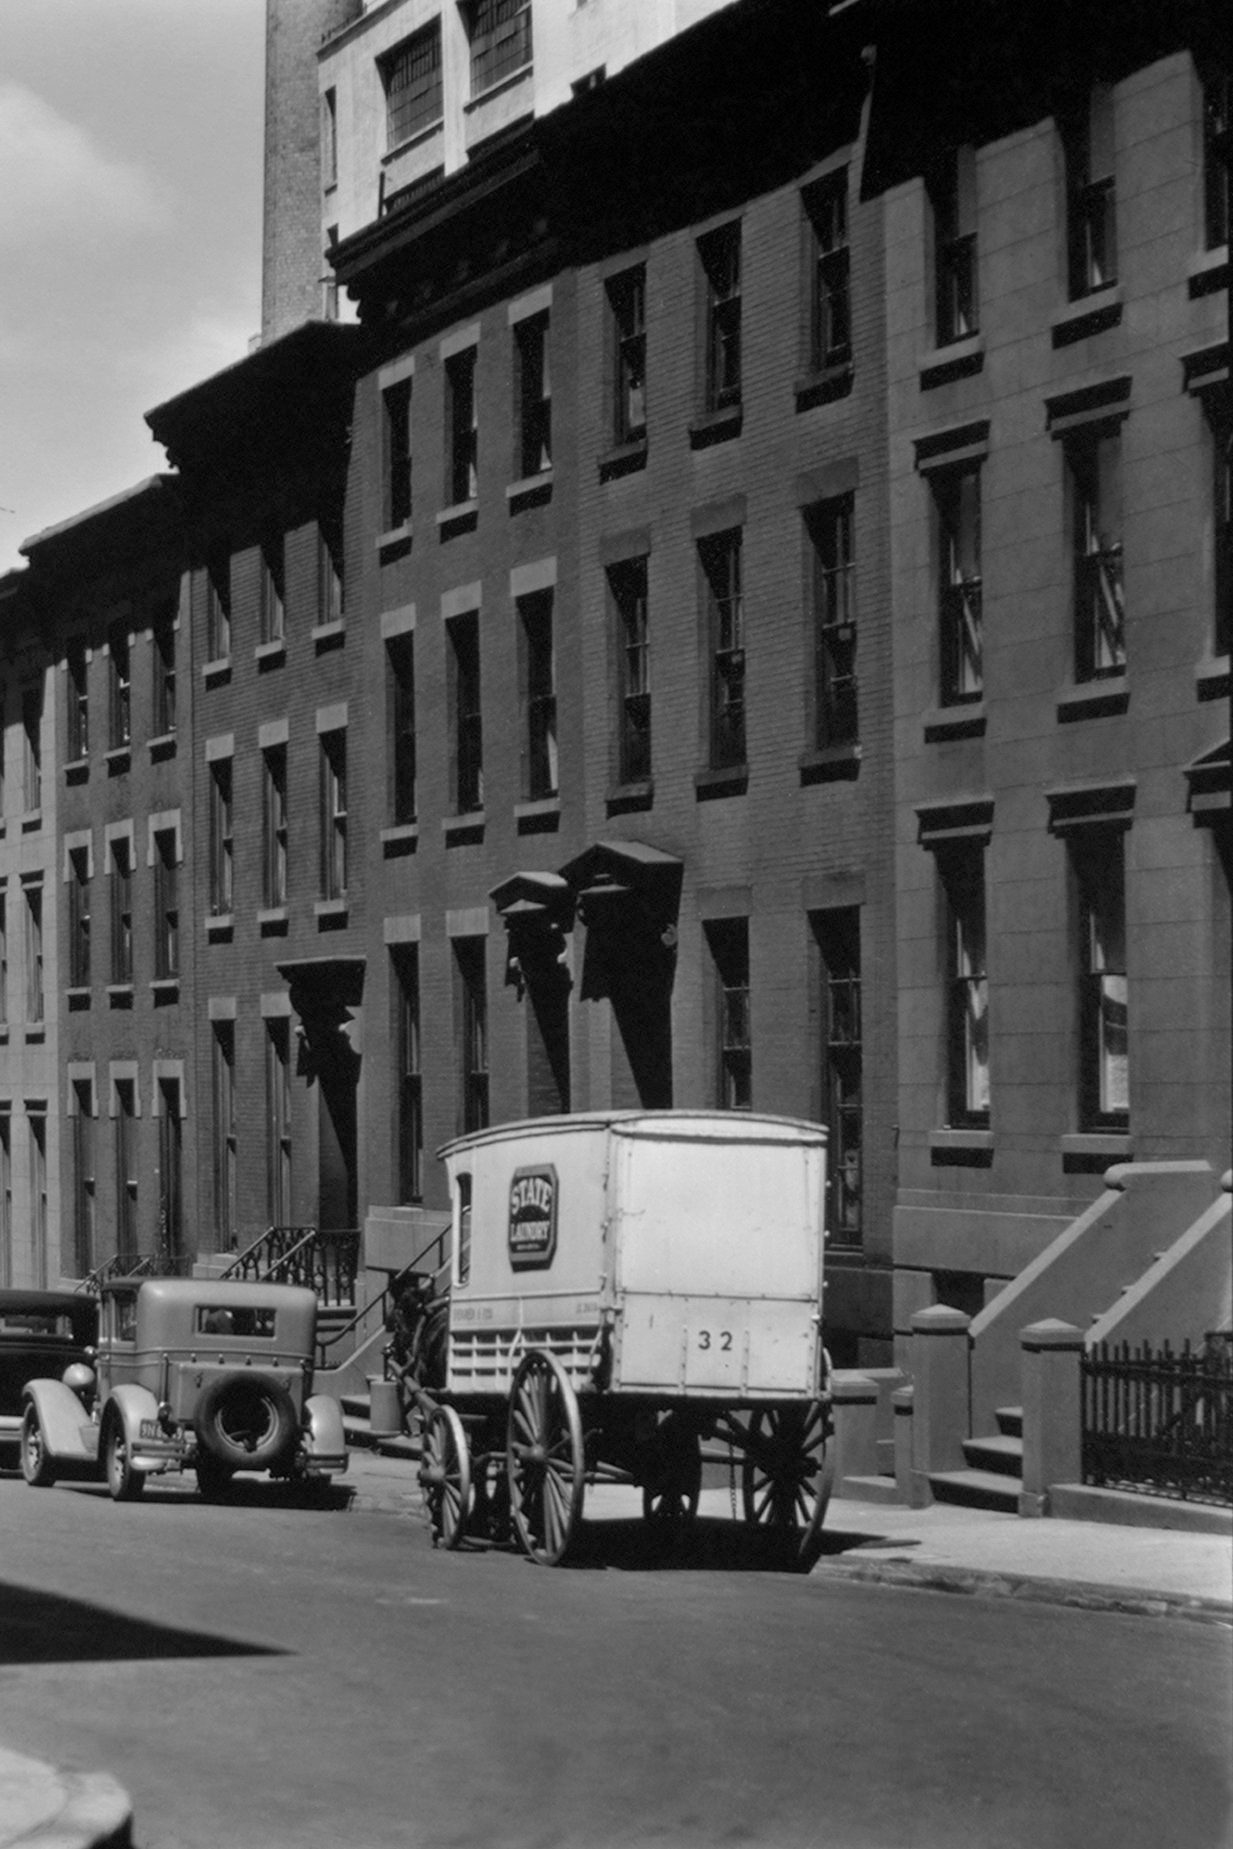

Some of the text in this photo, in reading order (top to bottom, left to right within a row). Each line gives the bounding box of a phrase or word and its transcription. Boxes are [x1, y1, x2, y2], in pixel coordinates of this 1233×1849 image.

[511, 1177, 553, 1215] STATE
[510, 1220, 551, 1241] LAUNDRY
[698, 1330, 733, 1351] 32
